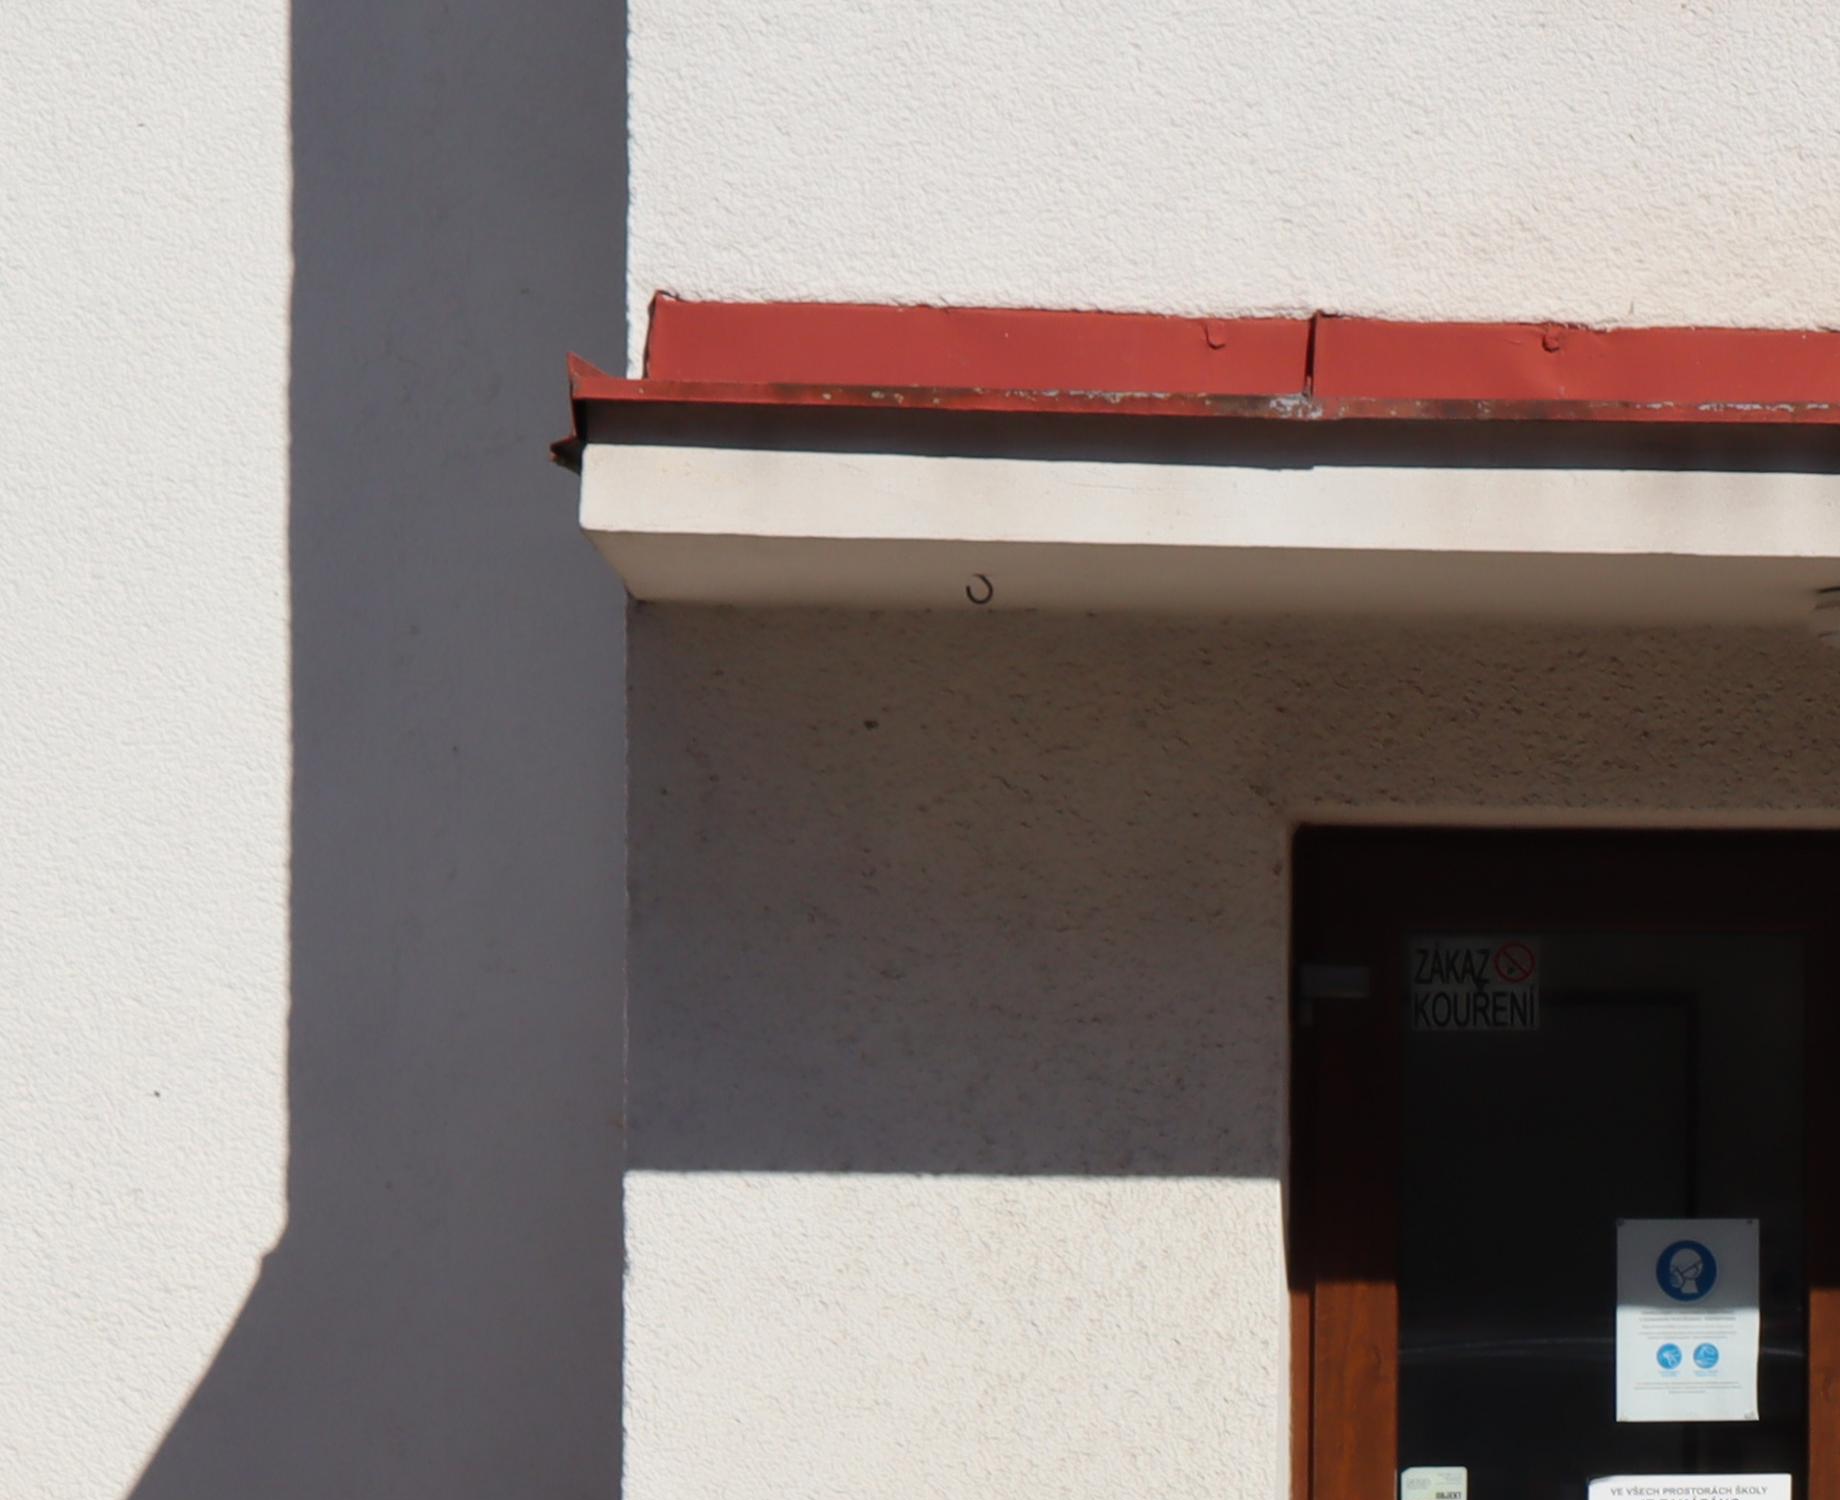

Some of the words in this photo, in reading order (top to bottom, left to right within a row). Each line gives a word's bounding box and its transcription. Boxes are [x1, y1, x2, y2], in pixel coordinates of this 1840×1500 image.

[1413, 942, 1490, 985] ZÁKAZ
[1413, 983, 1537, 1028] KOUŘENÍ
[1610, 1487, 1624, 1496] VE
[1626, 1485, 1660, 1496] VŠECH
[1662, 1484, 1733, 1495] PROSTORÁCH
[1735, 1484, 1768, 1495] ŠKOLY
